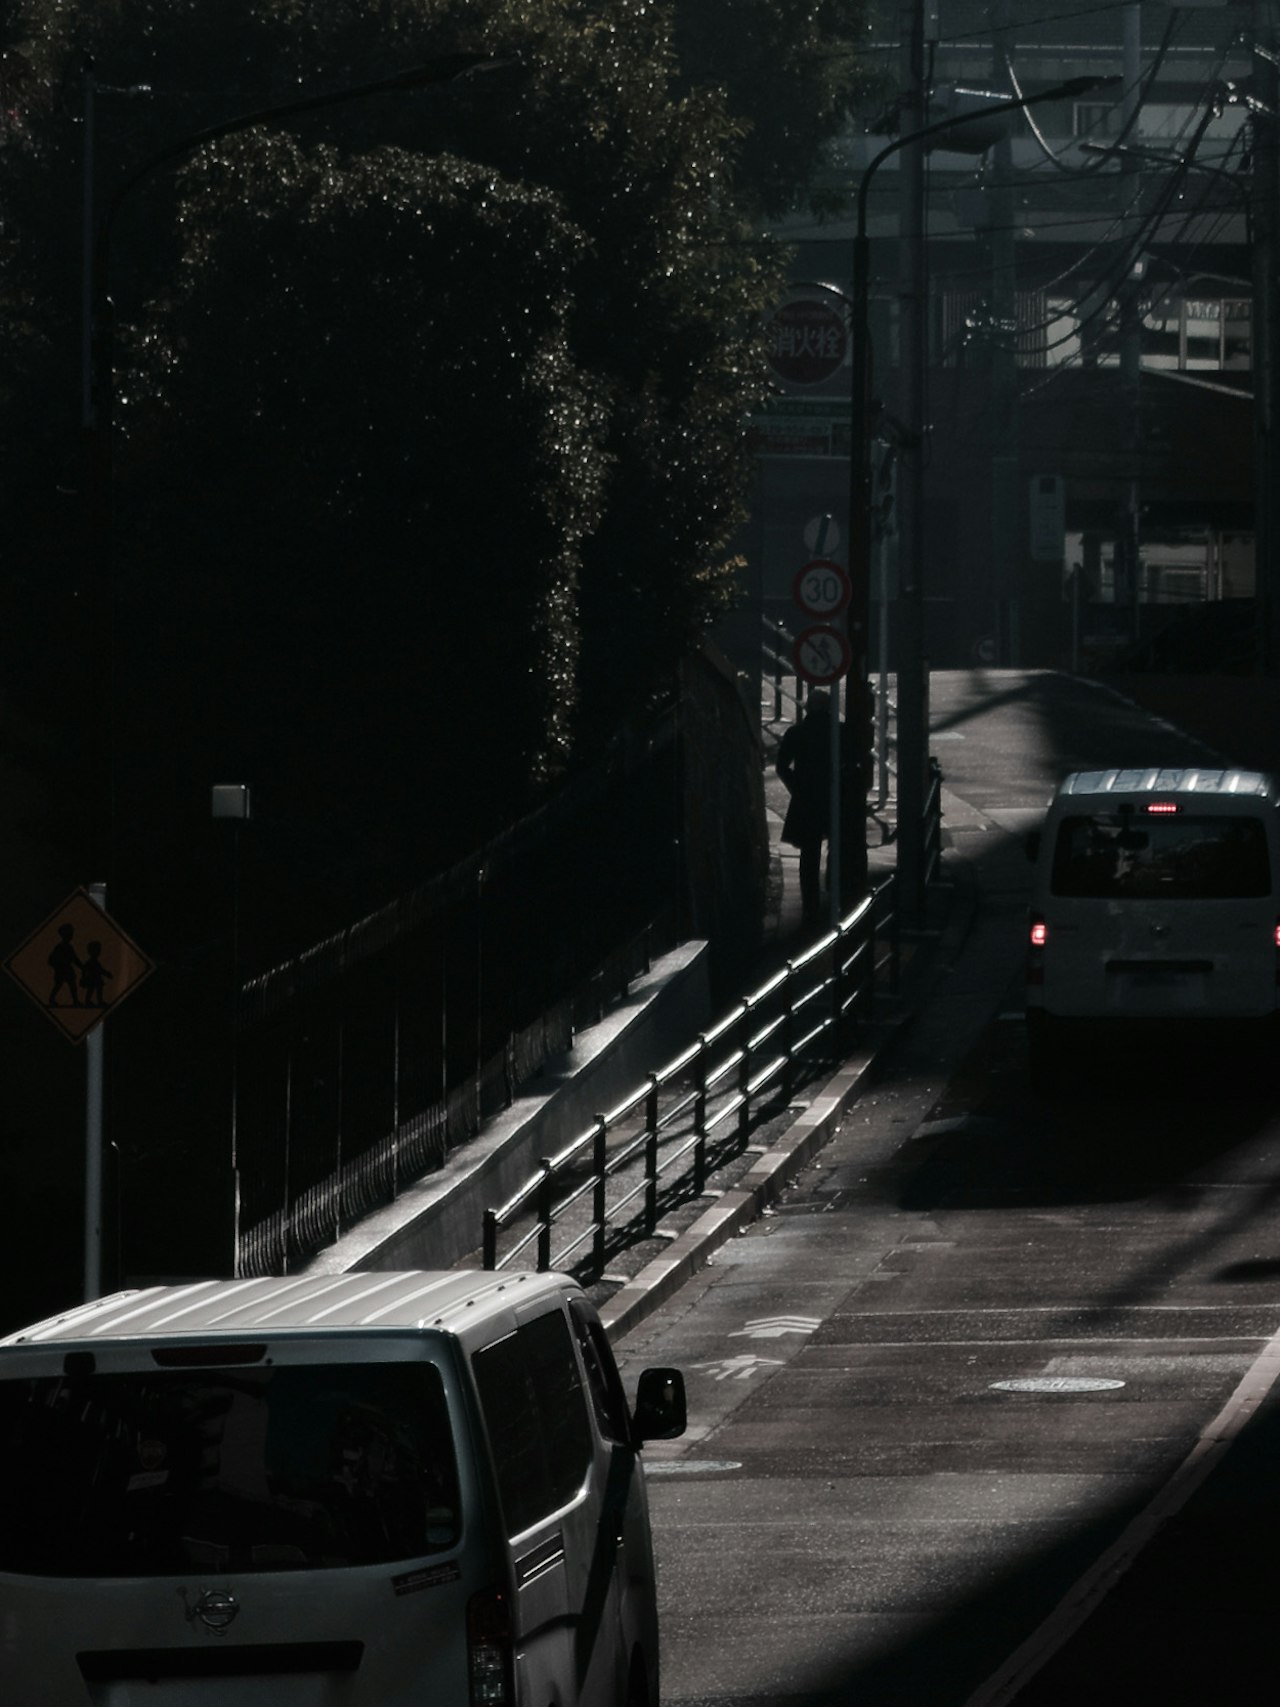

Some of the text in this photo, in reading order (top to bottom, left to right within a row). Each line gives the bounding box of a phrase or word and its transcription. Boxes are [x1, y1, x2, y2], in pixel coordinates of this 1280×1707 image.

[766, 325, 840, 359] 消火栓
[806, 575, 839, 603] 30
